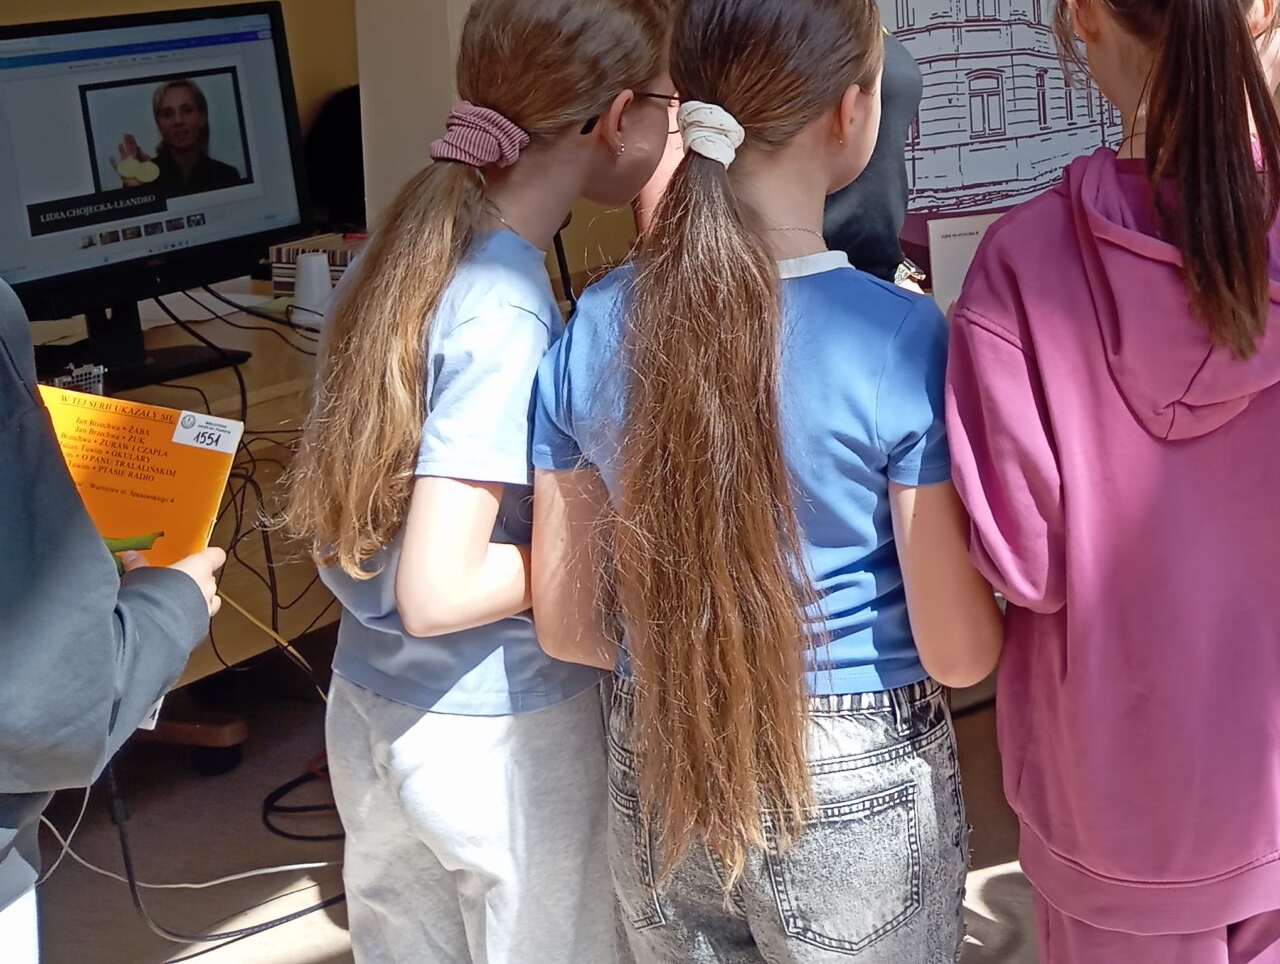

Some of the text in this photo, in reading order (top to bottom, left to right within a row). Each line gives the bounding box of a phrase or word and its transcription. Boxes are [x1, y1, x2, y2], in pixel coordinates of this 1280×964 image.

[40, 211, 66, 223] LIDIA
[193, 431, 221, 446] 1551
[111, 450, 152, 463] OKULARY
